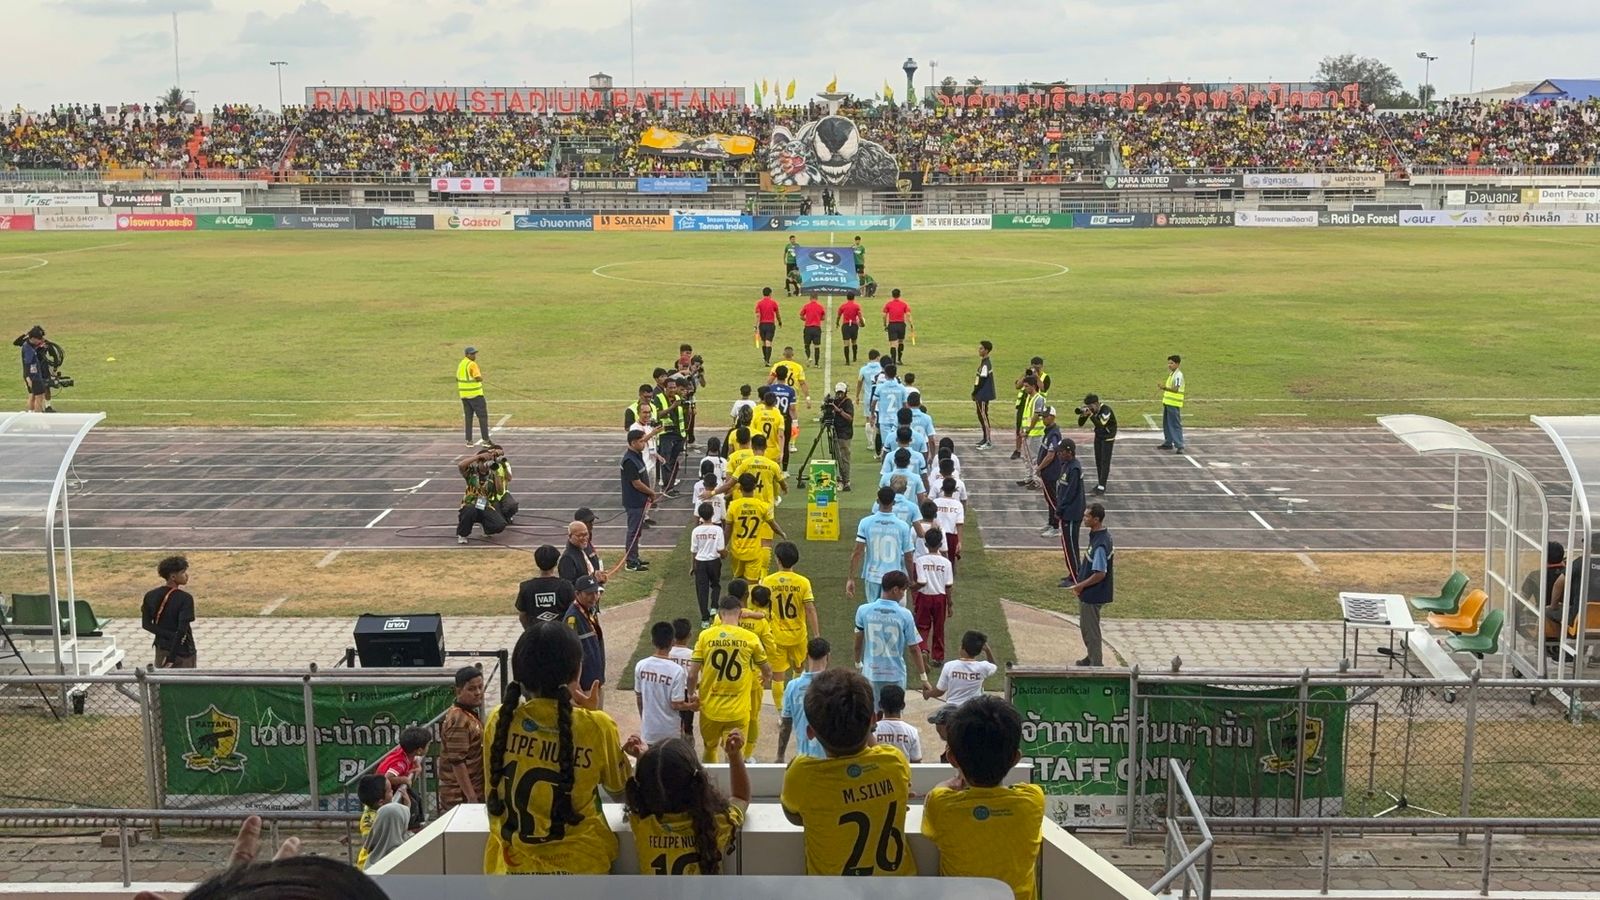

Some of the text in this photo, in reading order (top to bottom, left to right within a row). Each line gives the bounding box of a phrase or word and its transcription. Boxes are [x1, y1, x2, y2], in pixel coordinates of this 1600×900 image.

[315, 91, 736, 113] RAINBOW STADIUM PATTANI
[1118, 176, 1169, 184] NARA UNITED
[227, 215, 254, 226] Chang
[462, 218, 501, 227] Castrol
[540, 217, 592, 228] บ้านอากาศดี
[614, 216, 666, 225] SARAHAN
[784, 219, 810, 227] BYD
[927, 217, 991, 227] THE VIEW BEACH SAKOM
[1024, 214, 1051, 226] Chang
[1092, 216, 1107, 224] BG
[1331, 213, 1398, 224] Roti De Forest
[1411, 215, 1436, 224] GULF
[1498, 211, 1561, 225] ตุยง ค้าเหล็ก
[726, 222, 749, 230] Indah
[886, 393, 897, 413] 2
[763, 422, 772, 440] 9
[736, 516, 760, 539] 32
[872, 534, 897, 563] 10
[537, 595, 554, 604] VAR
[776, 593, 798, 620] 16
[707, 639, 748, 648] CARLOS NETO
[867, 623, 900, 657] 52
[711, 648, 742, 682] 96
[659, 673, 673, 687] FC
[969, 670, 981, 681] FC
[896, 733, 909, 744] FC
[538, 740, 594, 770] NUES
[842, 778, 895, 804] M.SILVA
[501, 759, 574, 845] 10
[648, 835, 680, 849] FELIPE
[838, 800, 904, 876] 26
